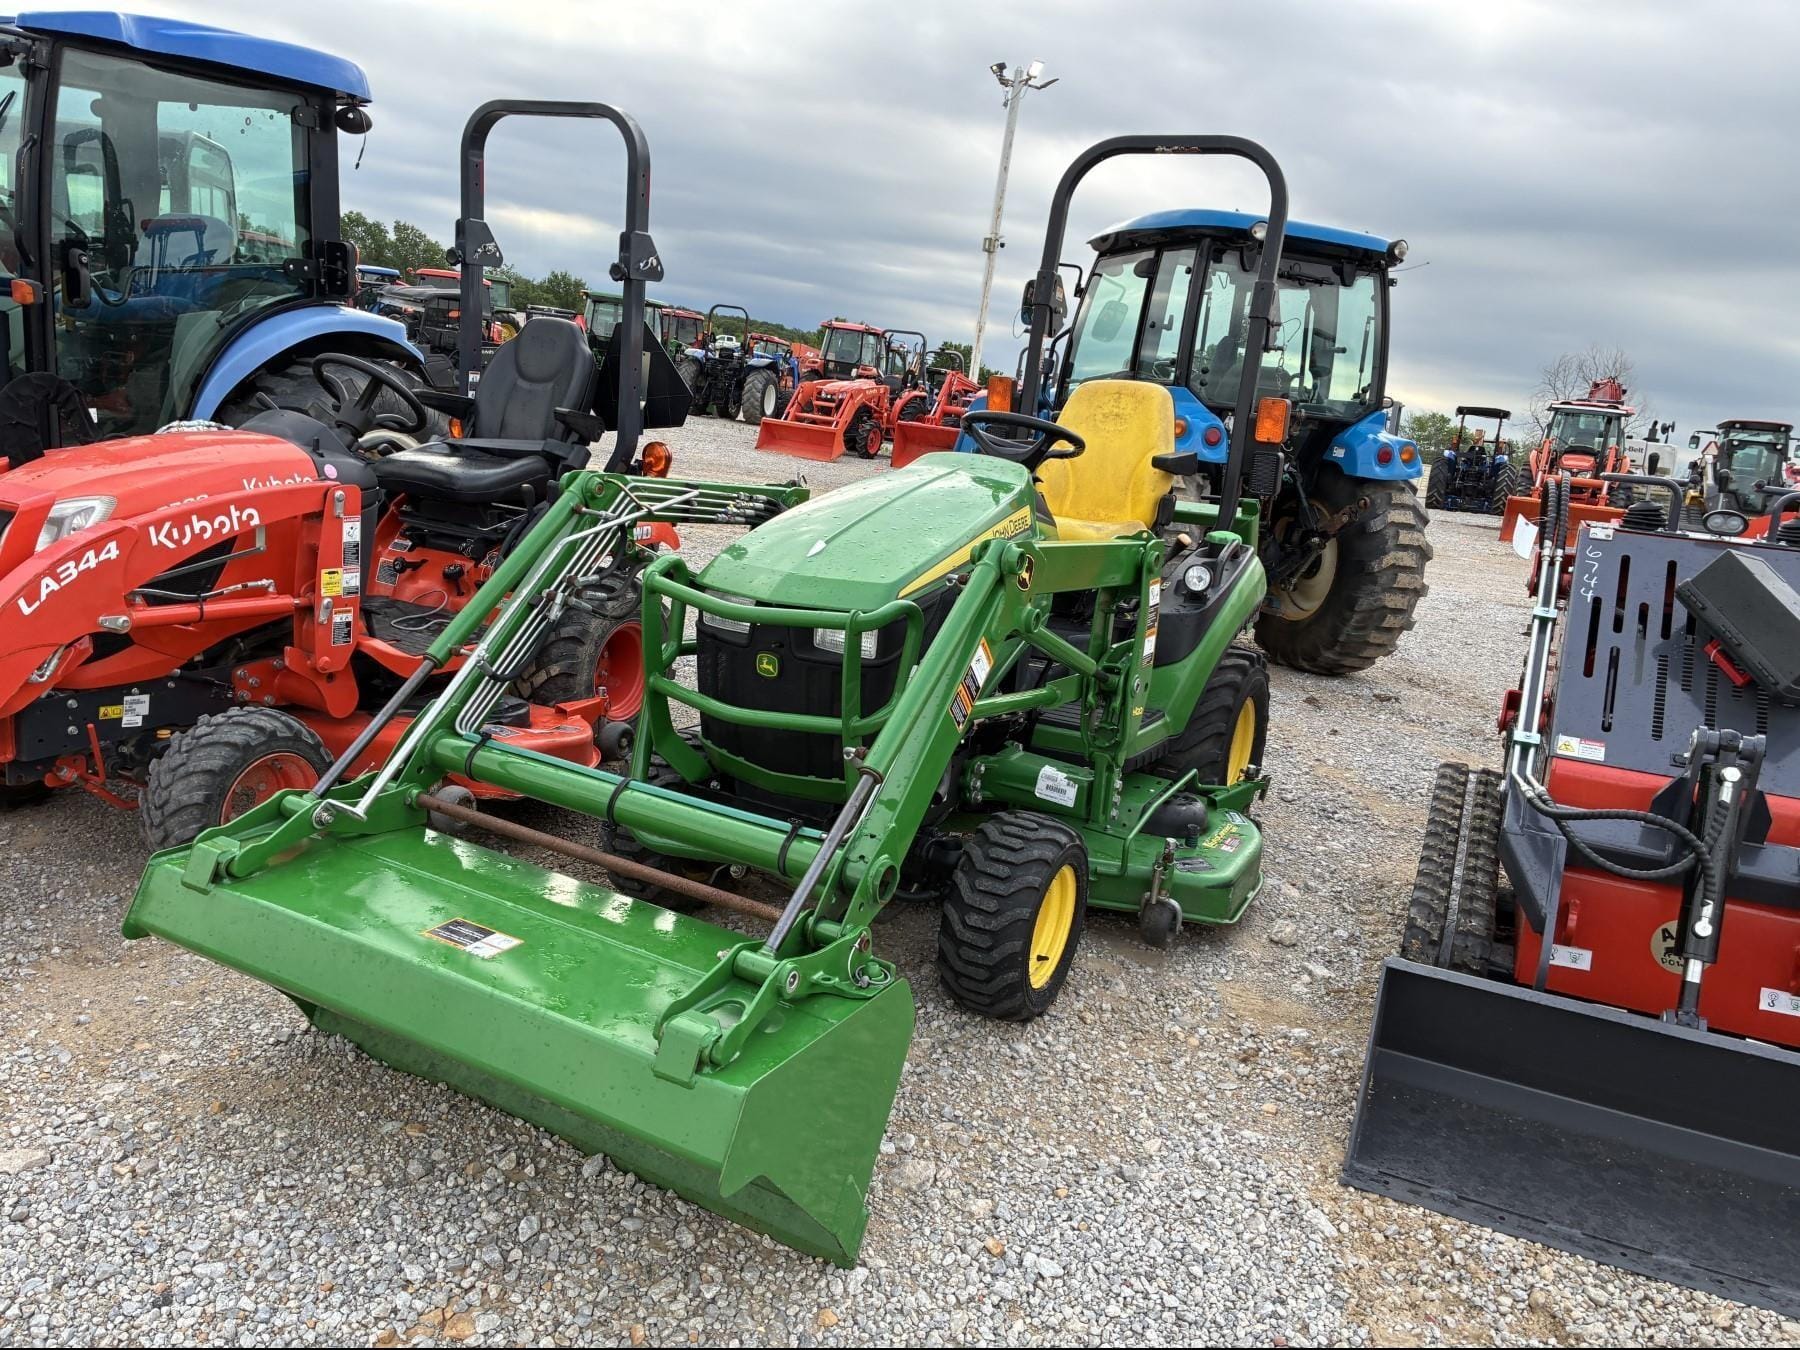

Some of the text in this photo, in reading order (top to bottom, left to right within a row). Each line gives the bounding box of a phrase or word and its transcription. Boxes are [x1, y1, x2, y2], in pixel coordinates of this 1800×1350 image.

[149, 504, 260, 549] Kubota
[632, 525, 653, 541] WD
[992, 515, 1030, 538] JOHN DEERE
[16, 540, 120, 616] LA344
[1580, 544, 1603, 603] 6744
